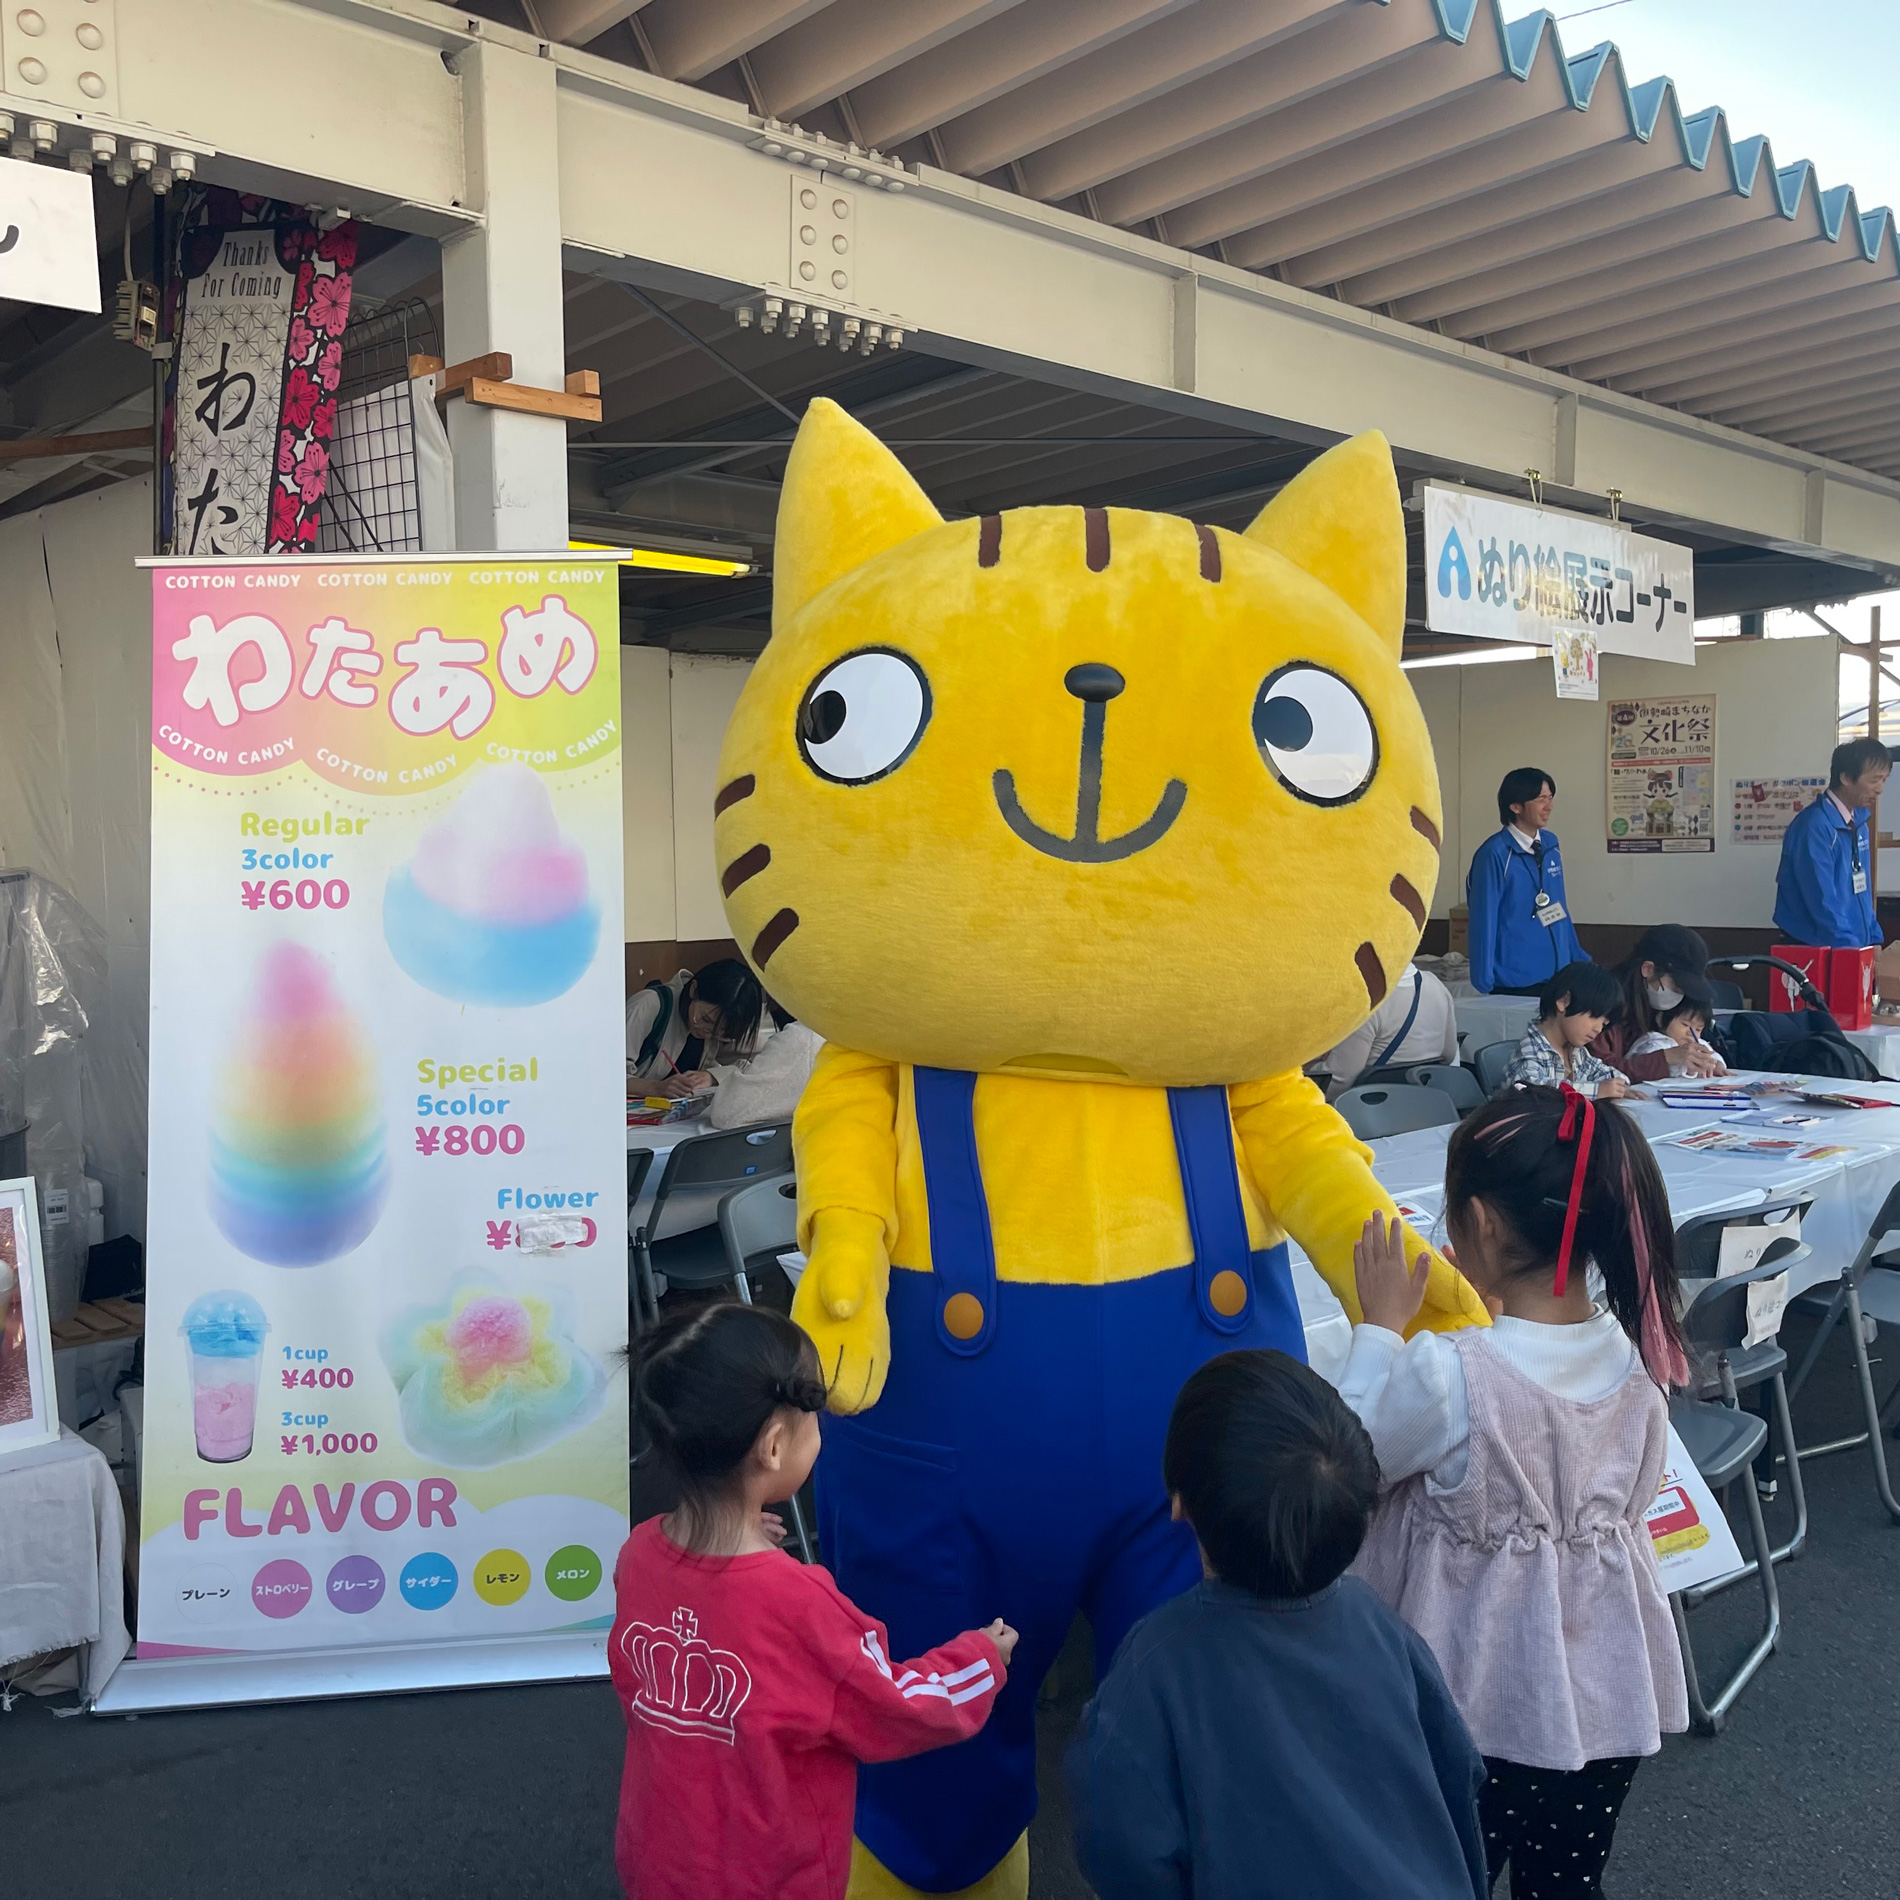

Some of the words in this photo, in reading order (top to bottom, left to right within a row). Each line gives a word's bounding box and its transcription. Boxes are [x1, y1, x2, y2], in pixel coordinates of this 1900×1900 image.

[222, 241, 270, 267] Thanks
[201, 273, 225, 298] For
[231, 271, 282, 300] Coming
[165, 575, 236, 589] COTTON
[244, 574, 301, 588] CANDY
[317, 573, 387, 587] COTTON
[396, 572, 453, 585] CANDY
[469, 571, 539, 584] COTTON
[547, 570, 605, 583] CANDY
[1477, 536, 1687, 633] ぬり絵展示コーナー
[170, 593, 599, 741] わたあめ
[158, 725, 228, 764] COTTON
[238, 737, 295, 765] CANDY
[486, 742, 557, 763] COTTON
[565, 719, 617, 758] CANDY
[1639, 718, 1710, 745] 文化祭
[316, 748, 388, 784] COTTON
[398, 754, 457, 783] CANDY
[240, 811, 370, 843] Regular
[241, 847, 334, 870] 3color
[241, 879, 350, 911] ¥600
[417, 1057, 538, 1089] Special
[417, 1094, 511, 1116] 5color
[415, 1124, 525, 1156] ¥800
[497, 1187, 599, 1210] Flower
[282, 1345, 329, 1364] 1cup
[281, 1367, 354, 1390] ¥400
[281, 1411, 329, 1430] 3cup
[280, 1432, 378, 1457] ¥1,000
[183, 1477, 458, 1540] FLAVOR
[182, 1588, 231, 1601] プレーン
[256, 1583, 309, 1596] ストロベリー
[332, 1578, 380, 1592] グレープ
[405, 1575, 452, 1588] サイダー
[486, 1573, 520, 1584] レモン
[556, 1569, 590, 1580] メロン
